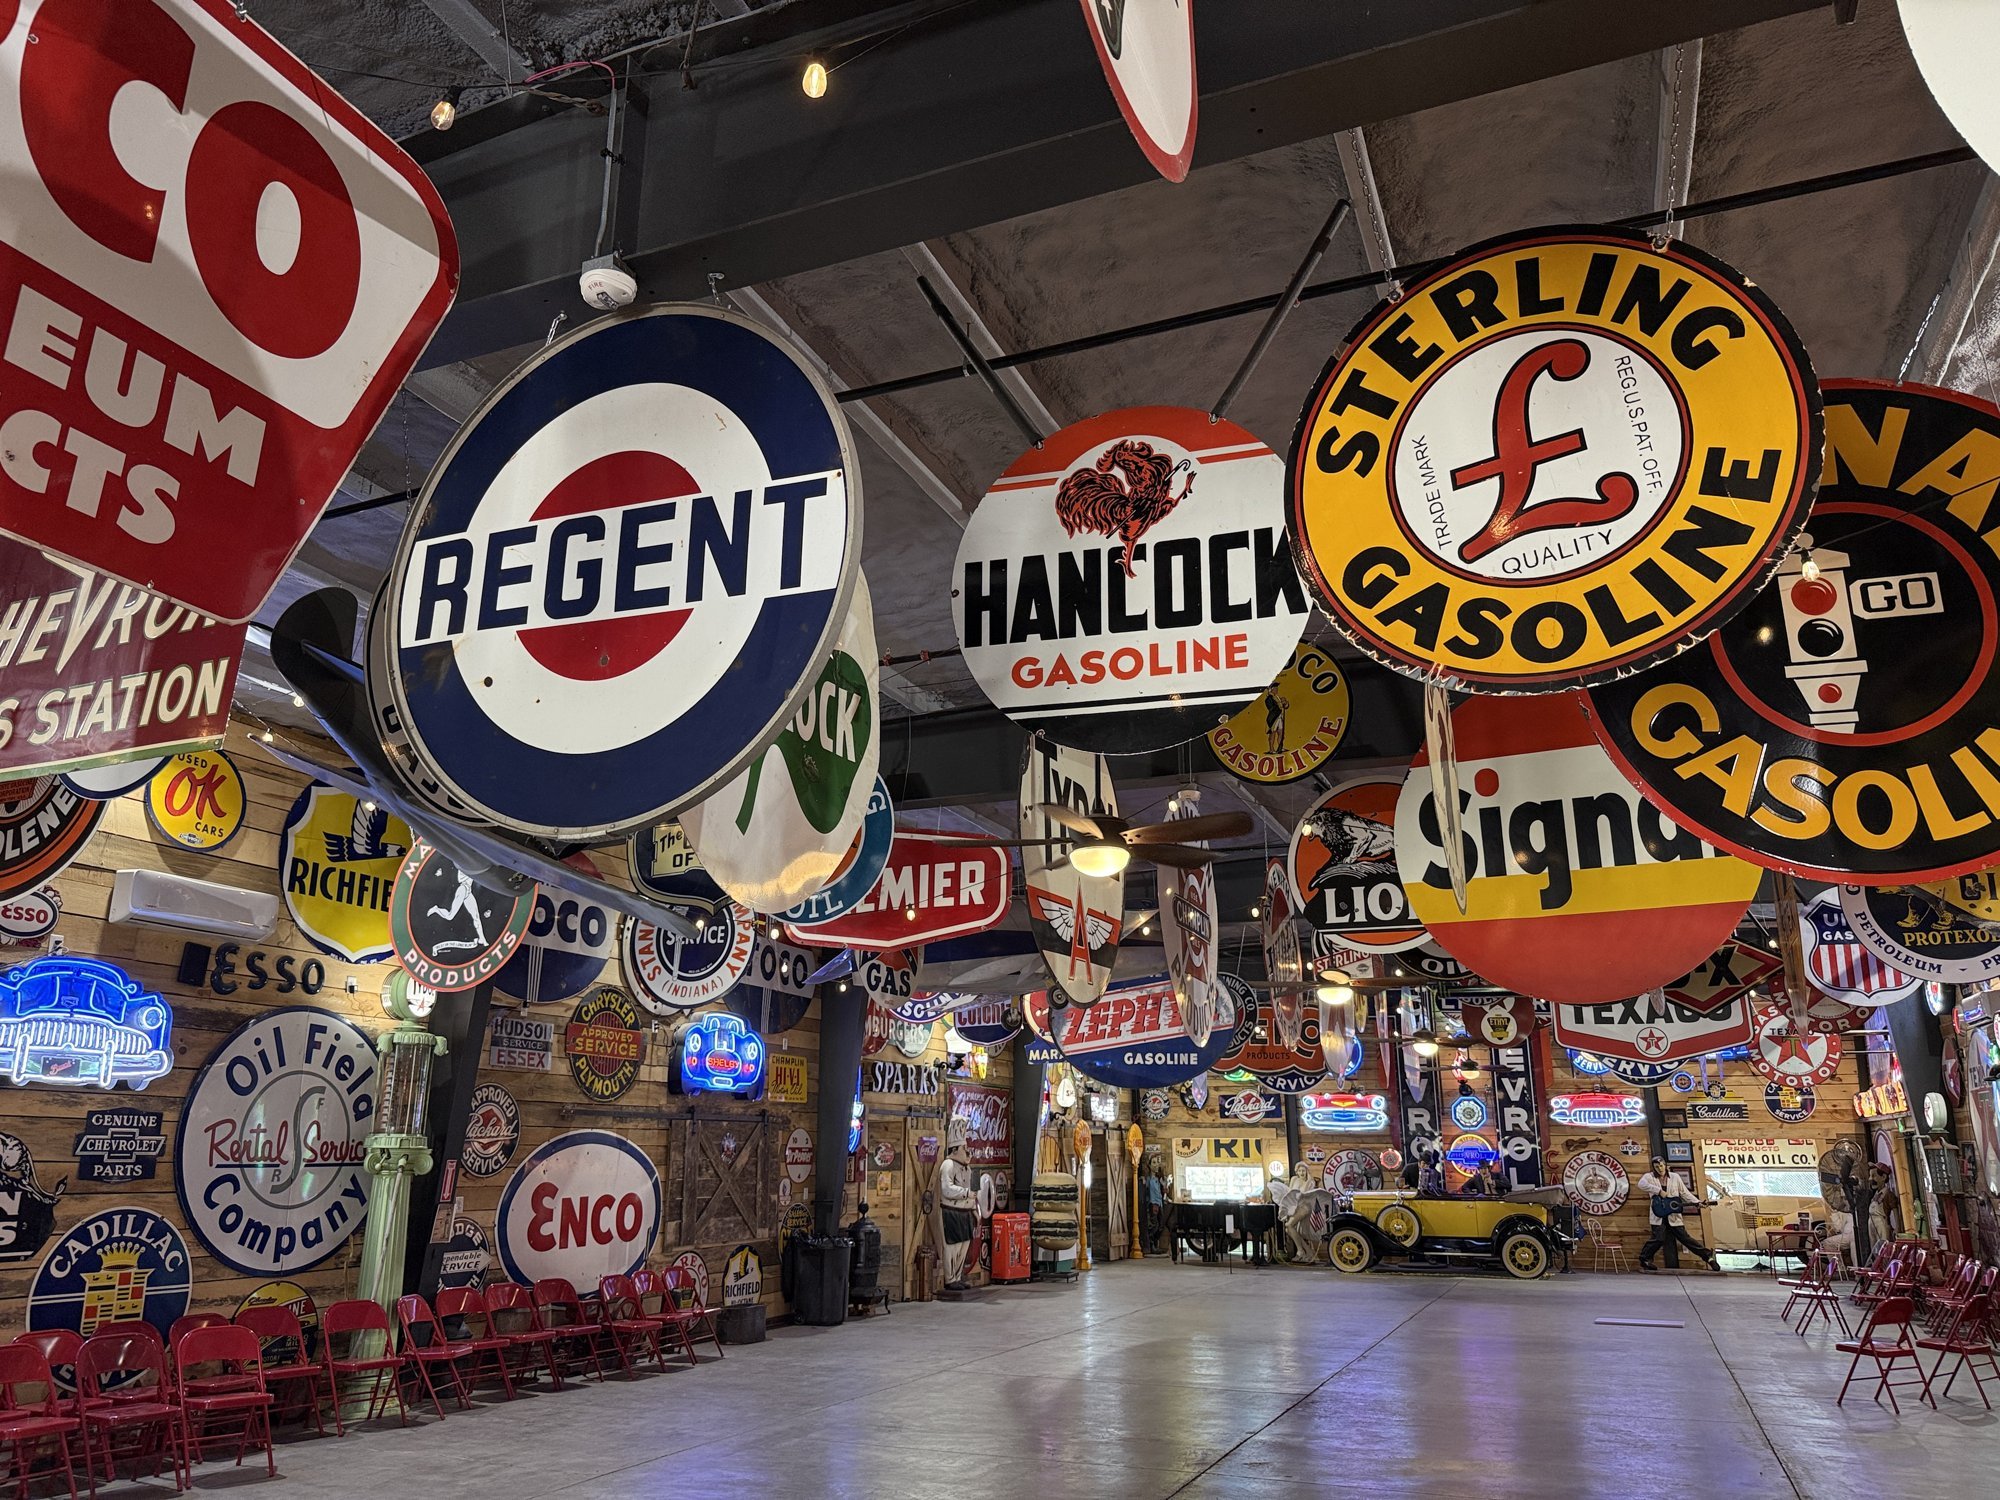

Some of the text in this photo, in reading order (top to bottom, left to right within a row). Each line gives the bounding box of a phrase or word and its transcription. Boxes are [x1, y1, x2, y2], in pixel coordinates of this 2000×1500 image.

[0, 0, 361, 360] CO
[1316, 252, 1746, 478] STERLING
[1411, 434, 1452, 549] TRADE MARK
[414, 476, 828, 642] REGENT
[1341, 446, 1783, 665] GASOLINE
[1502, 528, 1613, 576] QUALITY
[963, 525, 1309, 649] HANCOCK
[1859, 578, 1935, 613] GO
[1011, 632, 1250, 690] GASOLINE
[28, 655, 230, 746] STATION
[785, 680, 862, 764] OCK
[178, 754, 208, 769] USED
[1211, 716, 1344, 777] GASOLINE
[1631, 683, 2000, 851] GASOLI
[164, 763, 228, 820] OK
[195, 822, 224, 838] CARS
[660, 831, 683, 853] The
[1418, 768, 1734, 911] Signa
[673, 852, 695, 867] OF
[526, 893, 607, 949] OCO
[404, 931, 518, 986] PRODUCTS
[1854, 911, 1943, 975] PETROLEUM
[748, 942, 808, 990] OCO
[866, 962, 911, 998] GAS
[580, 993, 636, 1028] CHRYSLER
[1489, 1018, 1510, 1026] ETHYL
[502, 1038, 544, 1050] SERVICE
[574, 1038, 638, 1057] SERVICE
[581, 1026, 633, 1043] APPROVED
[1769, 1027, 1815, 1036] TEXAO
[225, 1026, 287, 1096] Oil
[496, 1048, 546, 1068] ESSEX
[707, 1057, 739, 1069] SHELBY
[772, 1055, 804, 1067] CHAMPLIN
[1123, 1052, 1198, 1066] GASOLINE
[1246, 1052, 1291, 1060] PRODUCTS
[1749, 1049, 1840, 1087] MOTOR OIL
[575, 1055, 635, 1097] PLYMOUTH
[872, 1061, 940, 1096] SPARKS
[1262, 1075, 1320, 1090] ERVIC
[471, 1088, 516, 1118] APPROVED
[1224, 1094, 1276, 1116] Packard
[1695, 1105, 1740, 1118] Cadillac
[1774, 1108, 1809, 1122] SERVICE
[91, 1114, 158, 1127] GENUINE
[465, 1112, 518, 1142] Packard
[86, 1138, 157, 1151] CHEVROLET
[203, 1119, 288, 1168] Rental
[93, 1164, 143, 1177] PARTS
[462, 1147, 508, 1177] SERVICE
[1325, 1154, 1343, 1176] RED
[1565, 1153, 1625, 1179] RED CROWN
[1761, 1154, 1786, 1165] OIL
[1791, 1154, 1811, 1166] CO.
[203, 1172, 368, 1264] Company
[527, 1181, 643, 1252] ENCO
[1568, 1190, 1627, 1214] GASOLINE
[50, 1213, 184, 1279] CADILLAC
[724, 1281, 760, 1298] RICHFIELD
